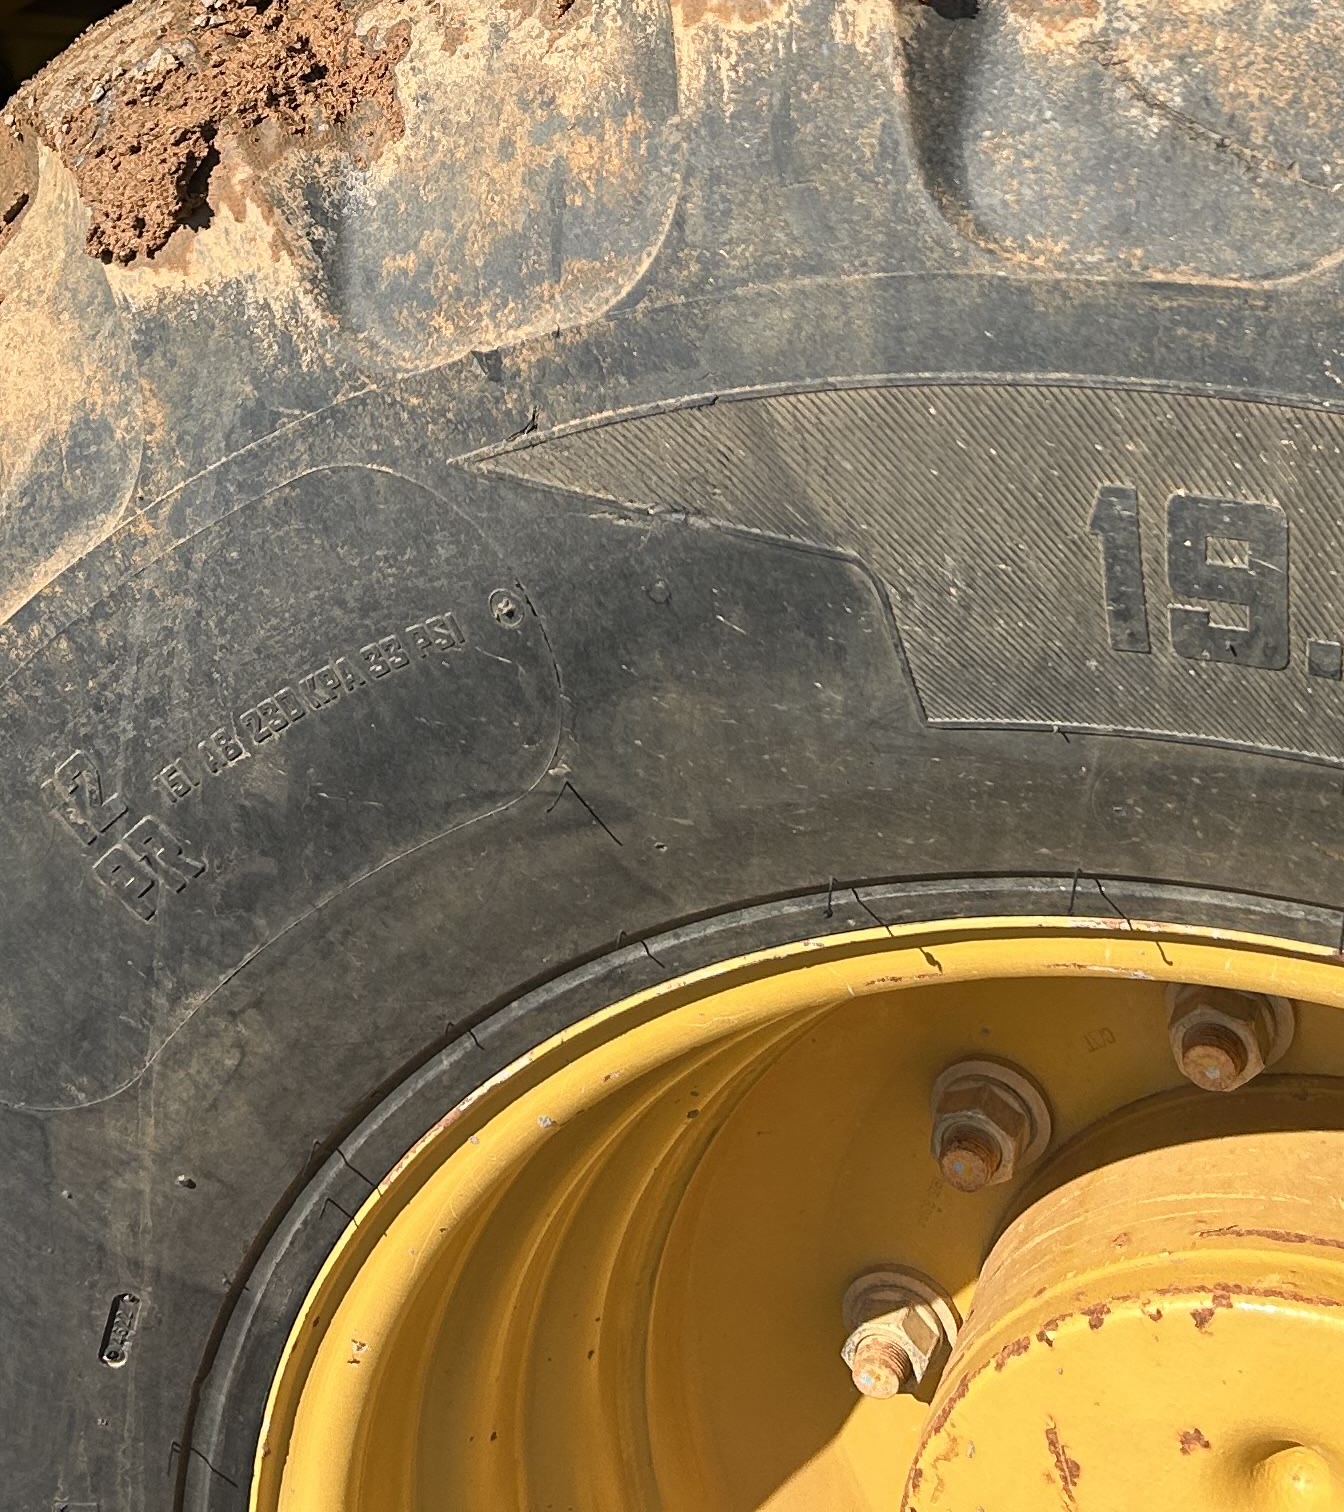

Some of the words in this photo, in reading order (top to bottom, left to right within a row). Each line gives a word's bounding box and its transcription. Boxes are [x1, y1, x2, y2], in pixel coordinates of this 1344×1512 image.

[359, 632, 412, 679] 33
[404, 611, 467, 662] PSI
[92, 814, 206, 923] PR
